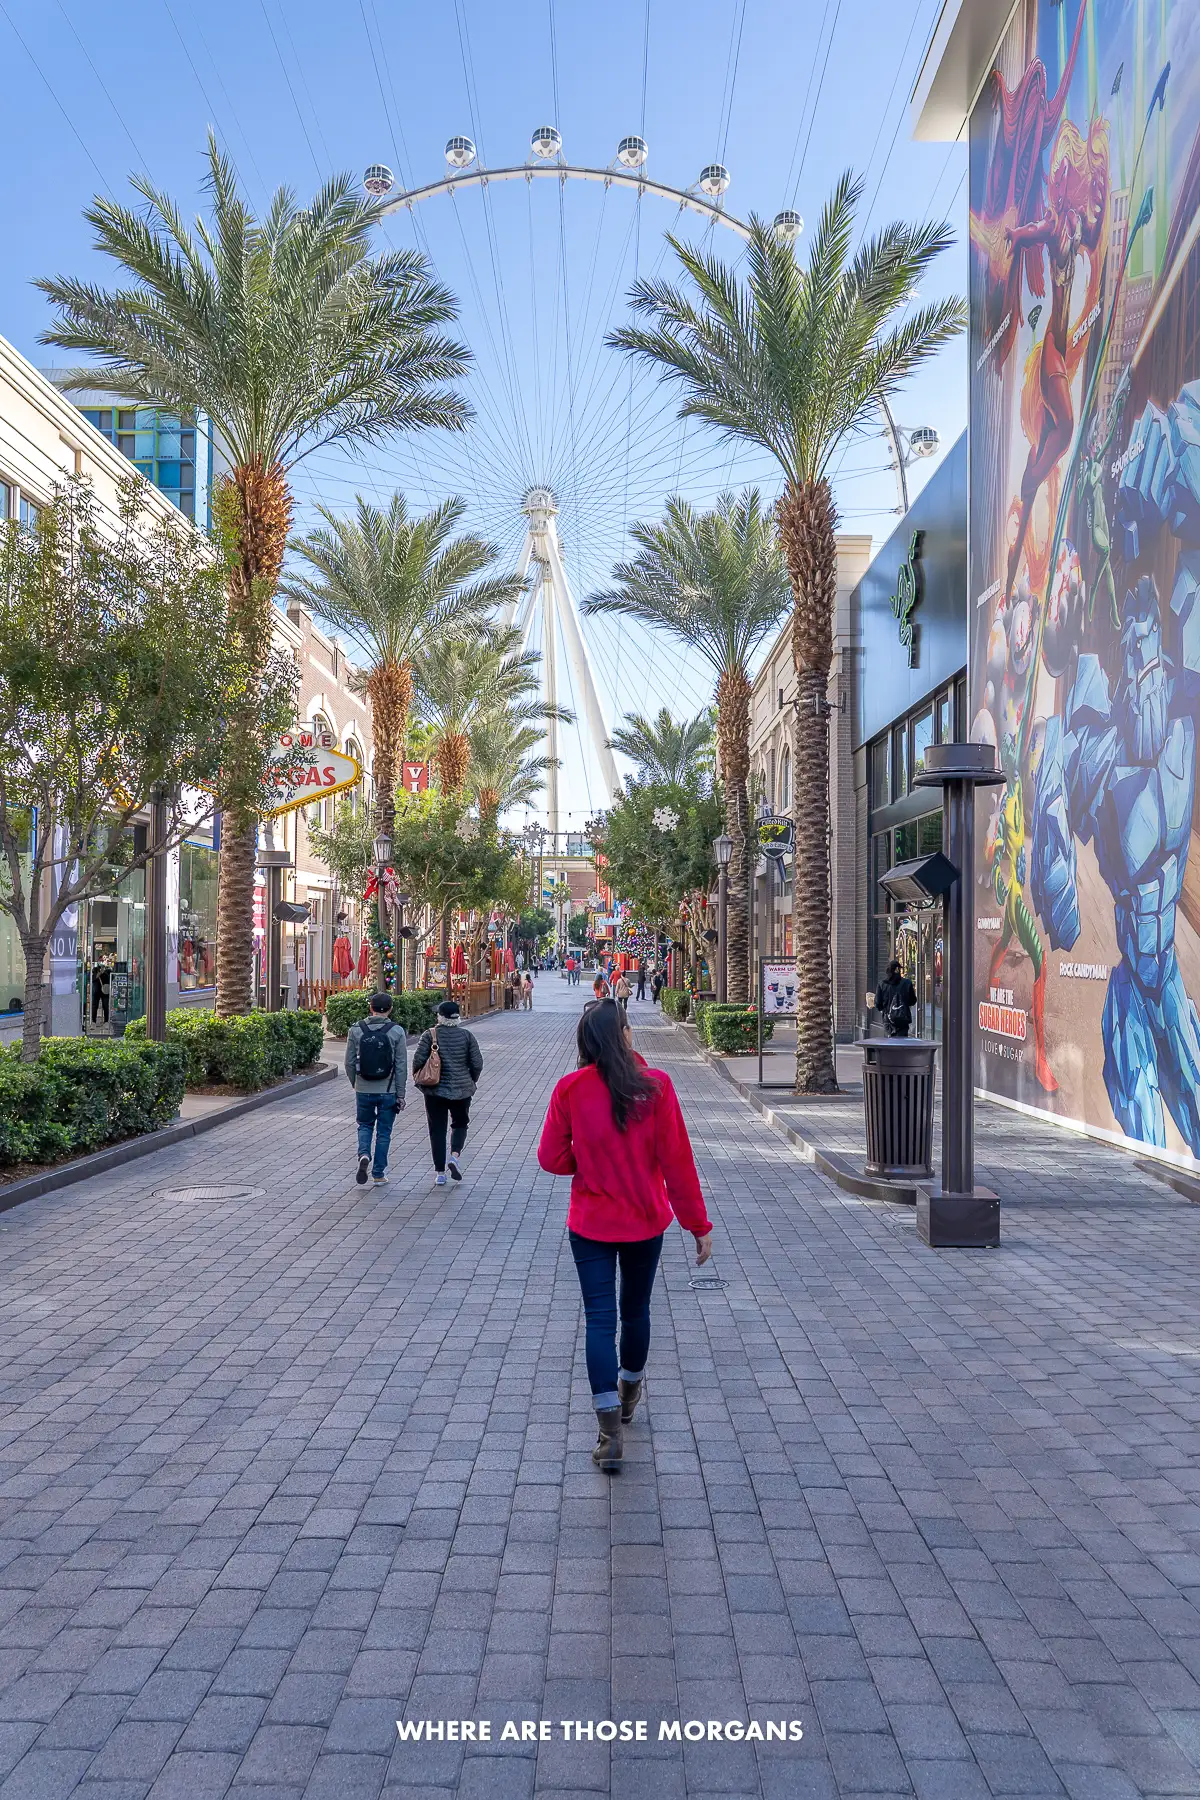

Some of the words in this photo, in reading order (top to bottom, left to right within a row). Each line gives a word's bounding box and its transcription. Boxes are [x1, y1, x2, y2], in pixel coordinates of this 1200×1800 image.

[991, 313, 1010, 349] MONSTER
[1111, 451, 1129, 478] SOUR
[1129, 439, 1145, 462] GIRL
[1060, 962, 1074, 977] ROCK
[1074, 963, 1107, 980] CANDYMAN
[990, 987, 998, 1002] WE
[997, 988, 1006, 1004] ARE
[1005, 989, 1014, 1005] THE
[980, 1003, 1000, 1032] SUGAR
[1000, 1007, 1026, 1038] HEROES
[985, 1040, 998, 1055] LOVE
[1003, 1045, 1022, 1062] SUGAR
